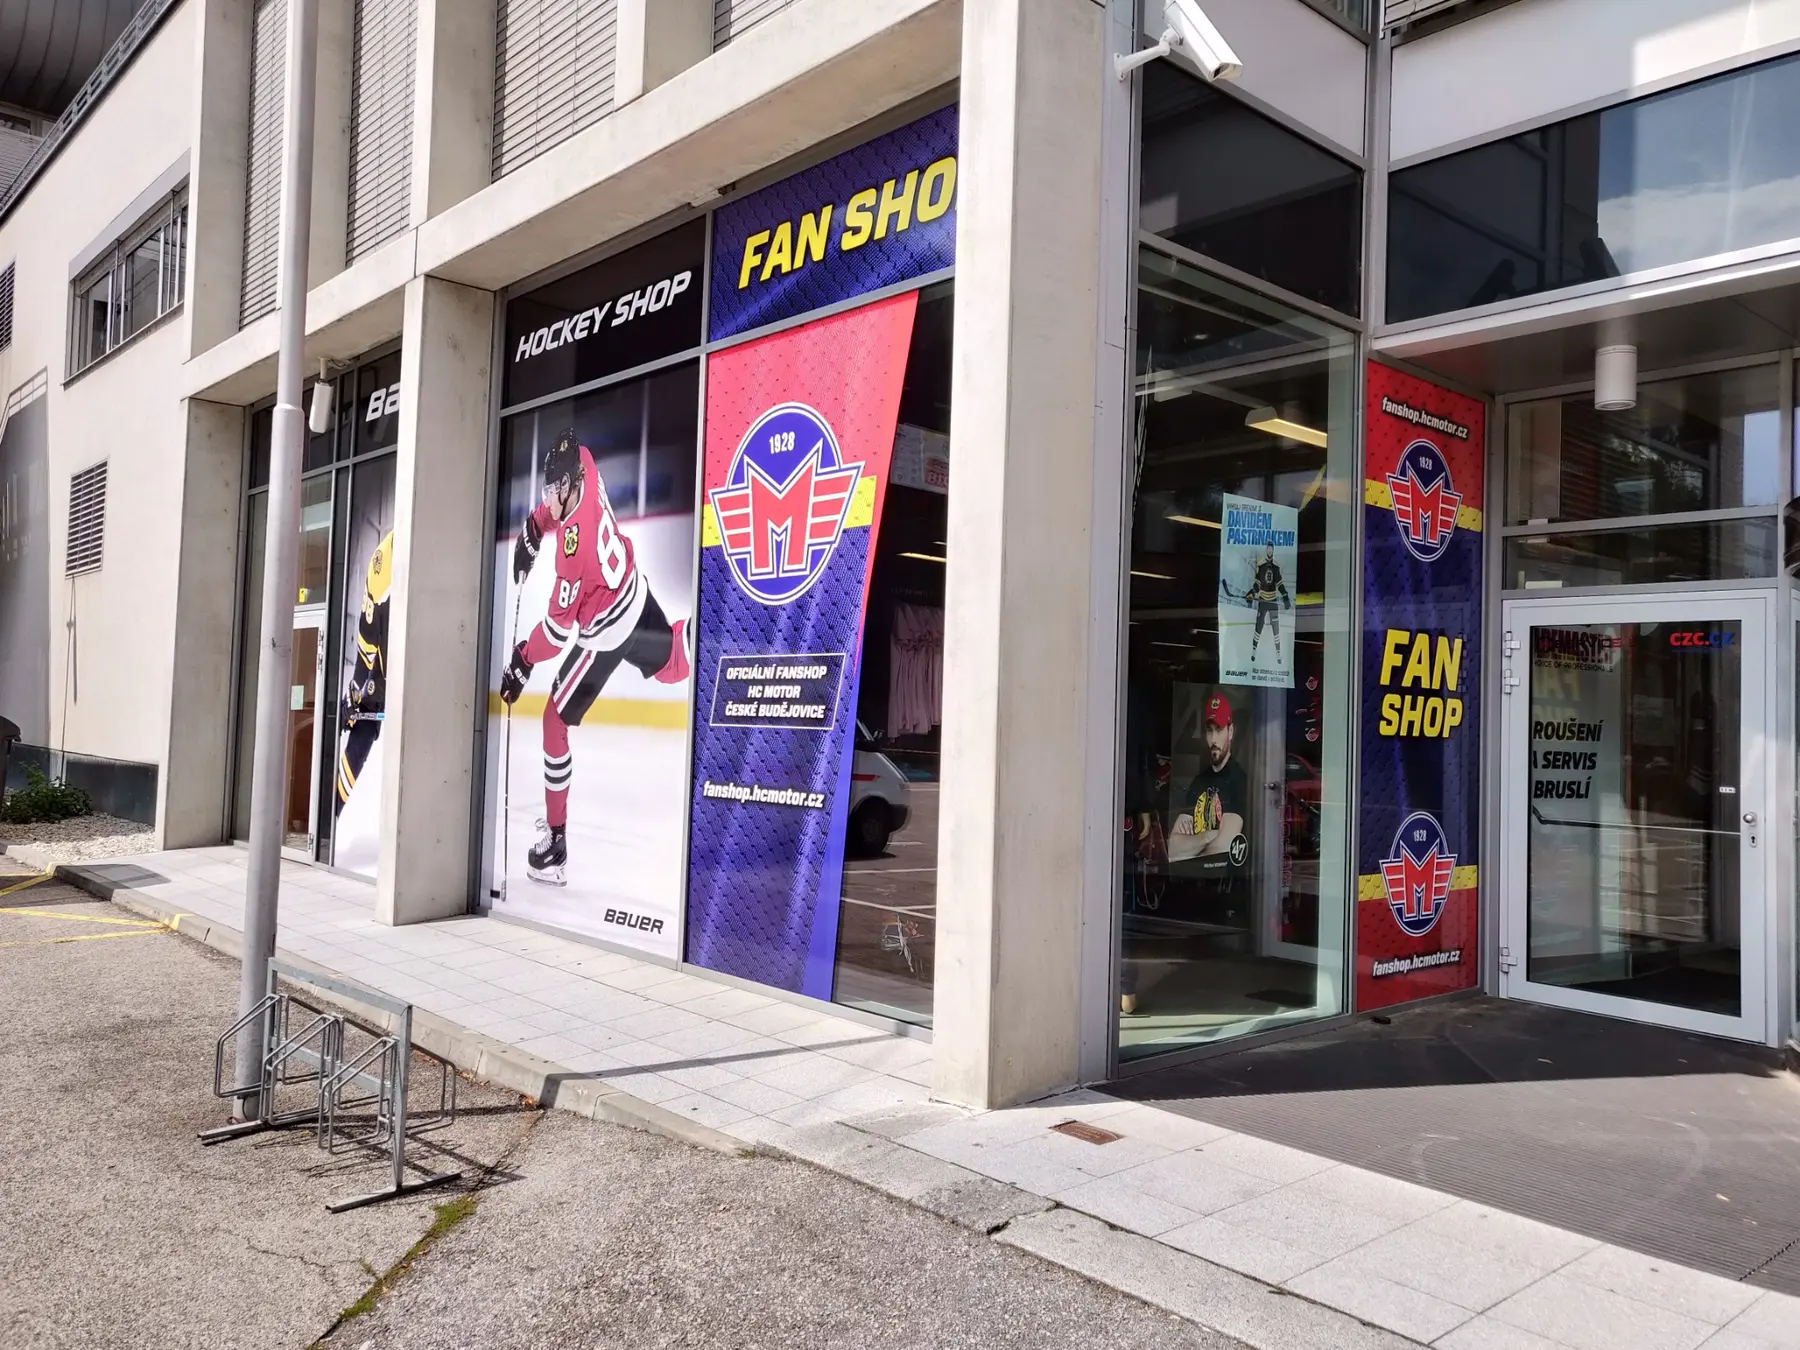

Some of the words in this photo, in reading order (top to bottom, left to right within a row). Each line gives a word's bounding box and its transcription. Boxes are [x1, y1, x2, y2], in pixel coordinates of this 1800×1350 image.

[738, 206, 831, 290] FAN
[841, 155, 957, 251] SHO
[515, 301, 613, 362] HOCKEY
[611, 270, 692, 327] SHOP
[365, 382, 401, 422] BA
[1382, 396, 1468, 438] fanshop.hcmotor.cz
[769, 431, 795, 453] 1928
[1419, 456, 1433, 470] 1928
[558, 579, 581, 609] 88
[726, 664, 776, 680] OFICIÁLNÍ
[775, 665, 827, 679] FANSHOP
[1379, 629, 1462, 692] FAN
[747, 685, 763, 699] HC
[763, 685, 801, 699] MOTOR
[725, 701, 758, 717] ČESKÉ
[758, 702, 826, 718] BUDĚJOVICE
[1379, 693, 1463, 738] SHOP
[1542, 751, 1598, 770] SERVIS
[703, 780, 825, 808] fanshop.hcmotor.cz
[1533, 776, 1592, 799] BRUSLÍ
[1413, 829, 1427, 842] 1928
[1373, 949, 1460, 977] fanshop.hcmotor.cz
